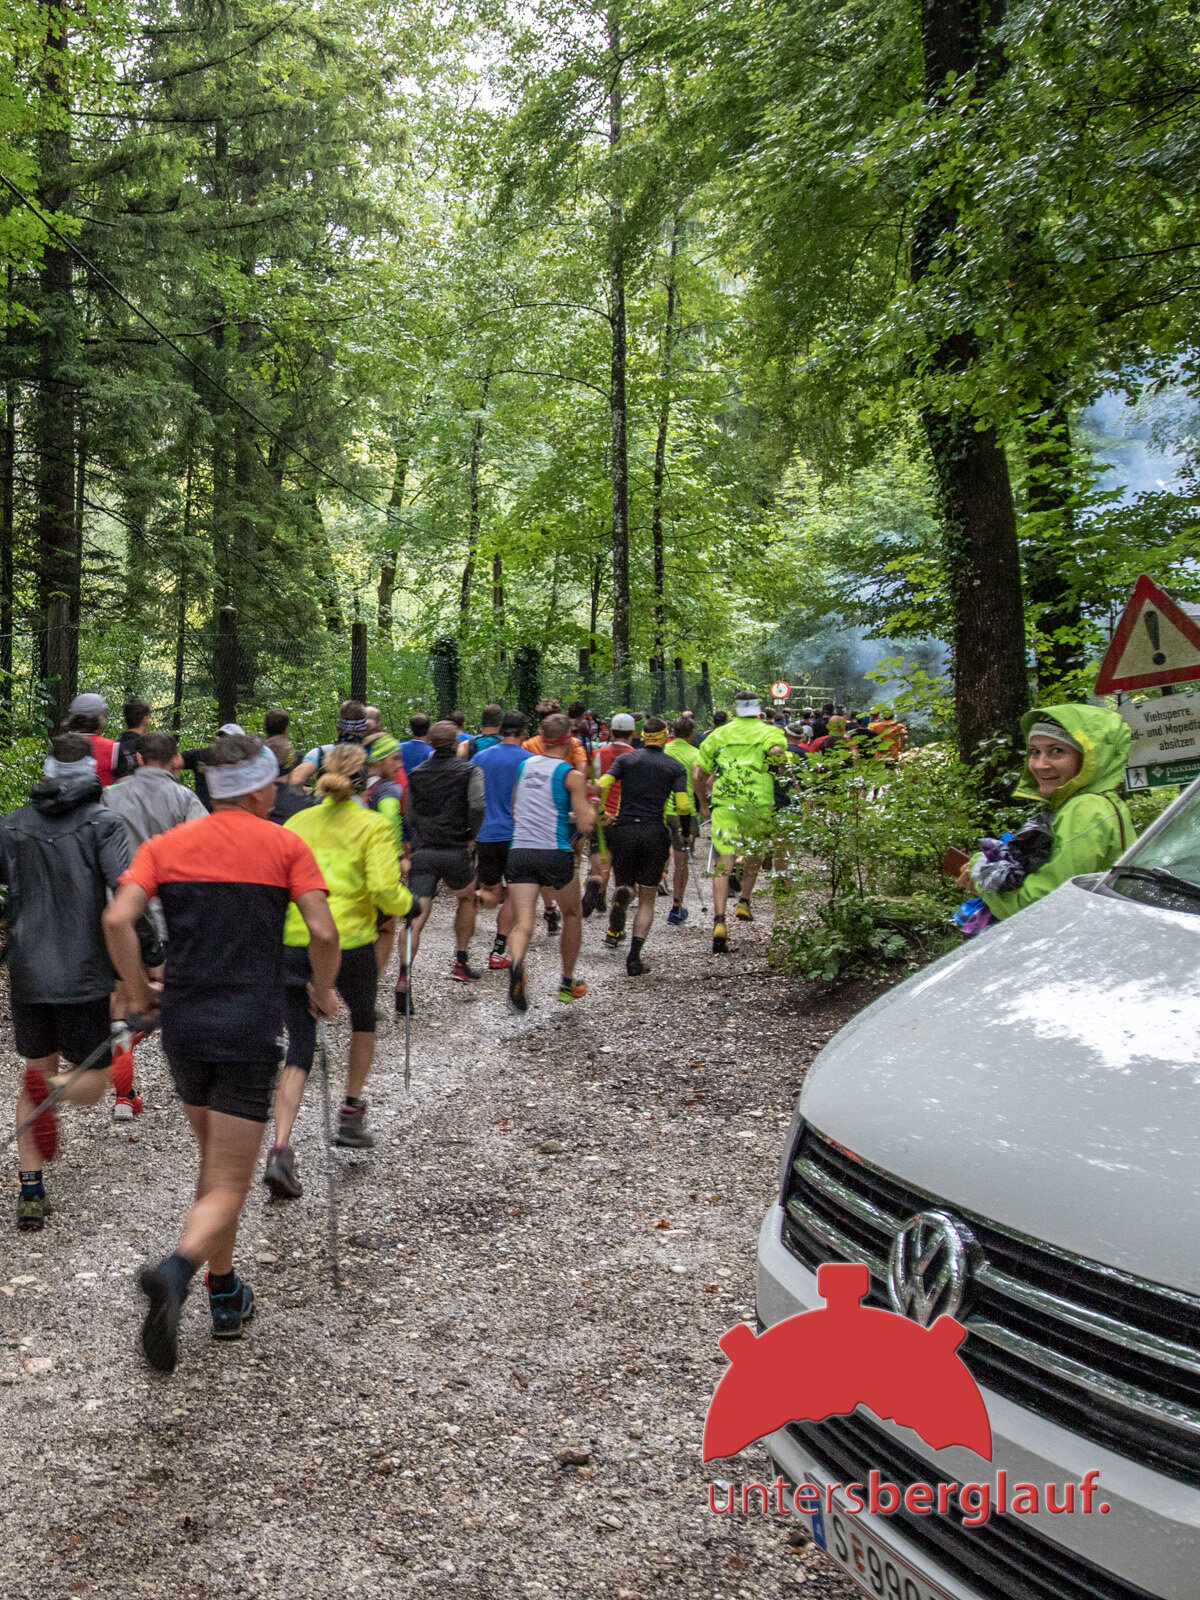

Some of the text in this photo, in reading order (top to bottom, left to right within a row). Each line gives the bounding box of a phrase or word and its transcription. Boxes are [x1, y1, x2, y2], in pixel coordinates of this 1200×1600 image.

[1131, 729, 1144, 741] ad-
[1147, 725, 1163, 738] und
[1159, 738, 1196, 751] absitzen
